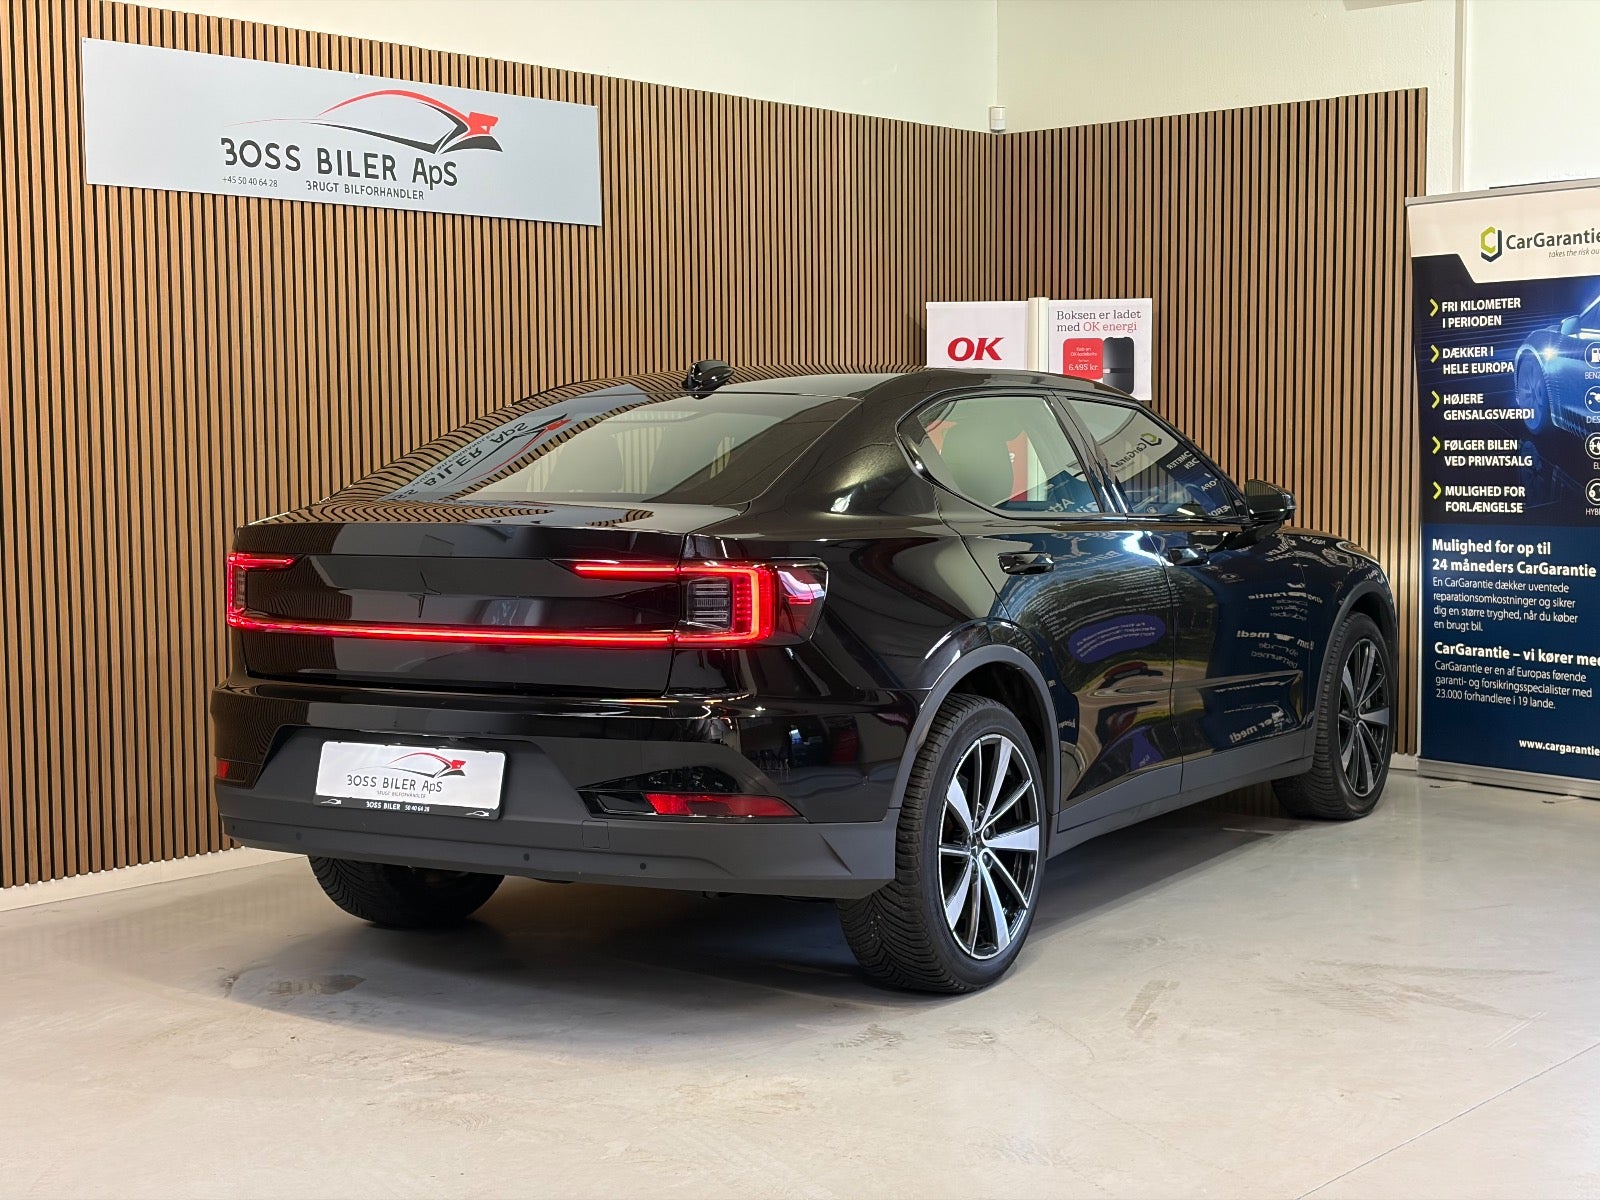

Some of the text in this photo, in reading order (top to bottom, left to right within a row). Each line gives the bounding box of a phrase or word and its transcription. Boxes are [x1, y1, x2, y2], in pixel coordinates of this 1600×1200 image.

[317, 148, 398, 181] BILER
[412, 157, 458, 190] ApS
[222, 176, 237, 184] +45
[238, 177, 247, 185] 50
[248, 178, 258, 186] 40
[258, 179, 268, 187] 64
[344, 184, 425, 200] BILFORHANDLER
[1506, 228, 1600, 250] CarGarantie
[1549, 250, 1566, 258] takes
[1578, 248, 1590, 256] risk
[1442, 297, 1521, 312] FRI KILOMETER
[1056, 309, 1142, 321] Boksen er ladet
[1442, 315, 1502, 328] I PERIODEN
[1056, 322, 1137, 333] med OK energi
[947, 337, 1005, 362] OK
[1442, 346, 1494, 359] DÆKKER I
[1068, 363, 1089, 371] 6.495
[1443, 362, 1514, 375] HELE EUROPA
[1443, 393, 1484, 405] HØJERE
[1444, 408, 1535, 421] GENSALGSVÆRDI
[1444, 439, 1518, 451] FØLGER BILEN
[1445, 455, 1533, 467] VED PRIVATSALG
[1445, 485, 1525, 497] MULIGHED FOR
[1445, 501, 1523, 513] FORLÆNGELSE
[1432, 538, 1551, 557] Mulighed for op til
[1432, 558, 1597, 577] 24 måneders CarGarantie
[1433, 577, 1570, 593] En CarGarantie dækker uventede
[1433, 592, 1576, 609] reparationsomkostninger og sikrer
[1433, 605, 1579, 624] dig en større tryghed, når du køber
[1433, 620, 1483, 633] en brugt bil.
[1434, 641, 1510, 660] CarGarantie
[1523, 648, 1535, 662] vi
[1538, 649, 1574, 665] kører
[1434, 660, 1587, 683] CarGarantie er en af Europas førende
[1435, 676, 1593, 698] garanti- og forsikringsspecialister med
[1436, 689, 1463, 700] 23.000
[1464, 690, 1512, 705] forhandlere
[1518, 696, 1528, 706] 19
[1530, 696, 1556, 709] lande.
[383, 777, 416, 791] BILER
[421, 780, 443, 794] ApS
[383, 802, 401, 810] BILER
